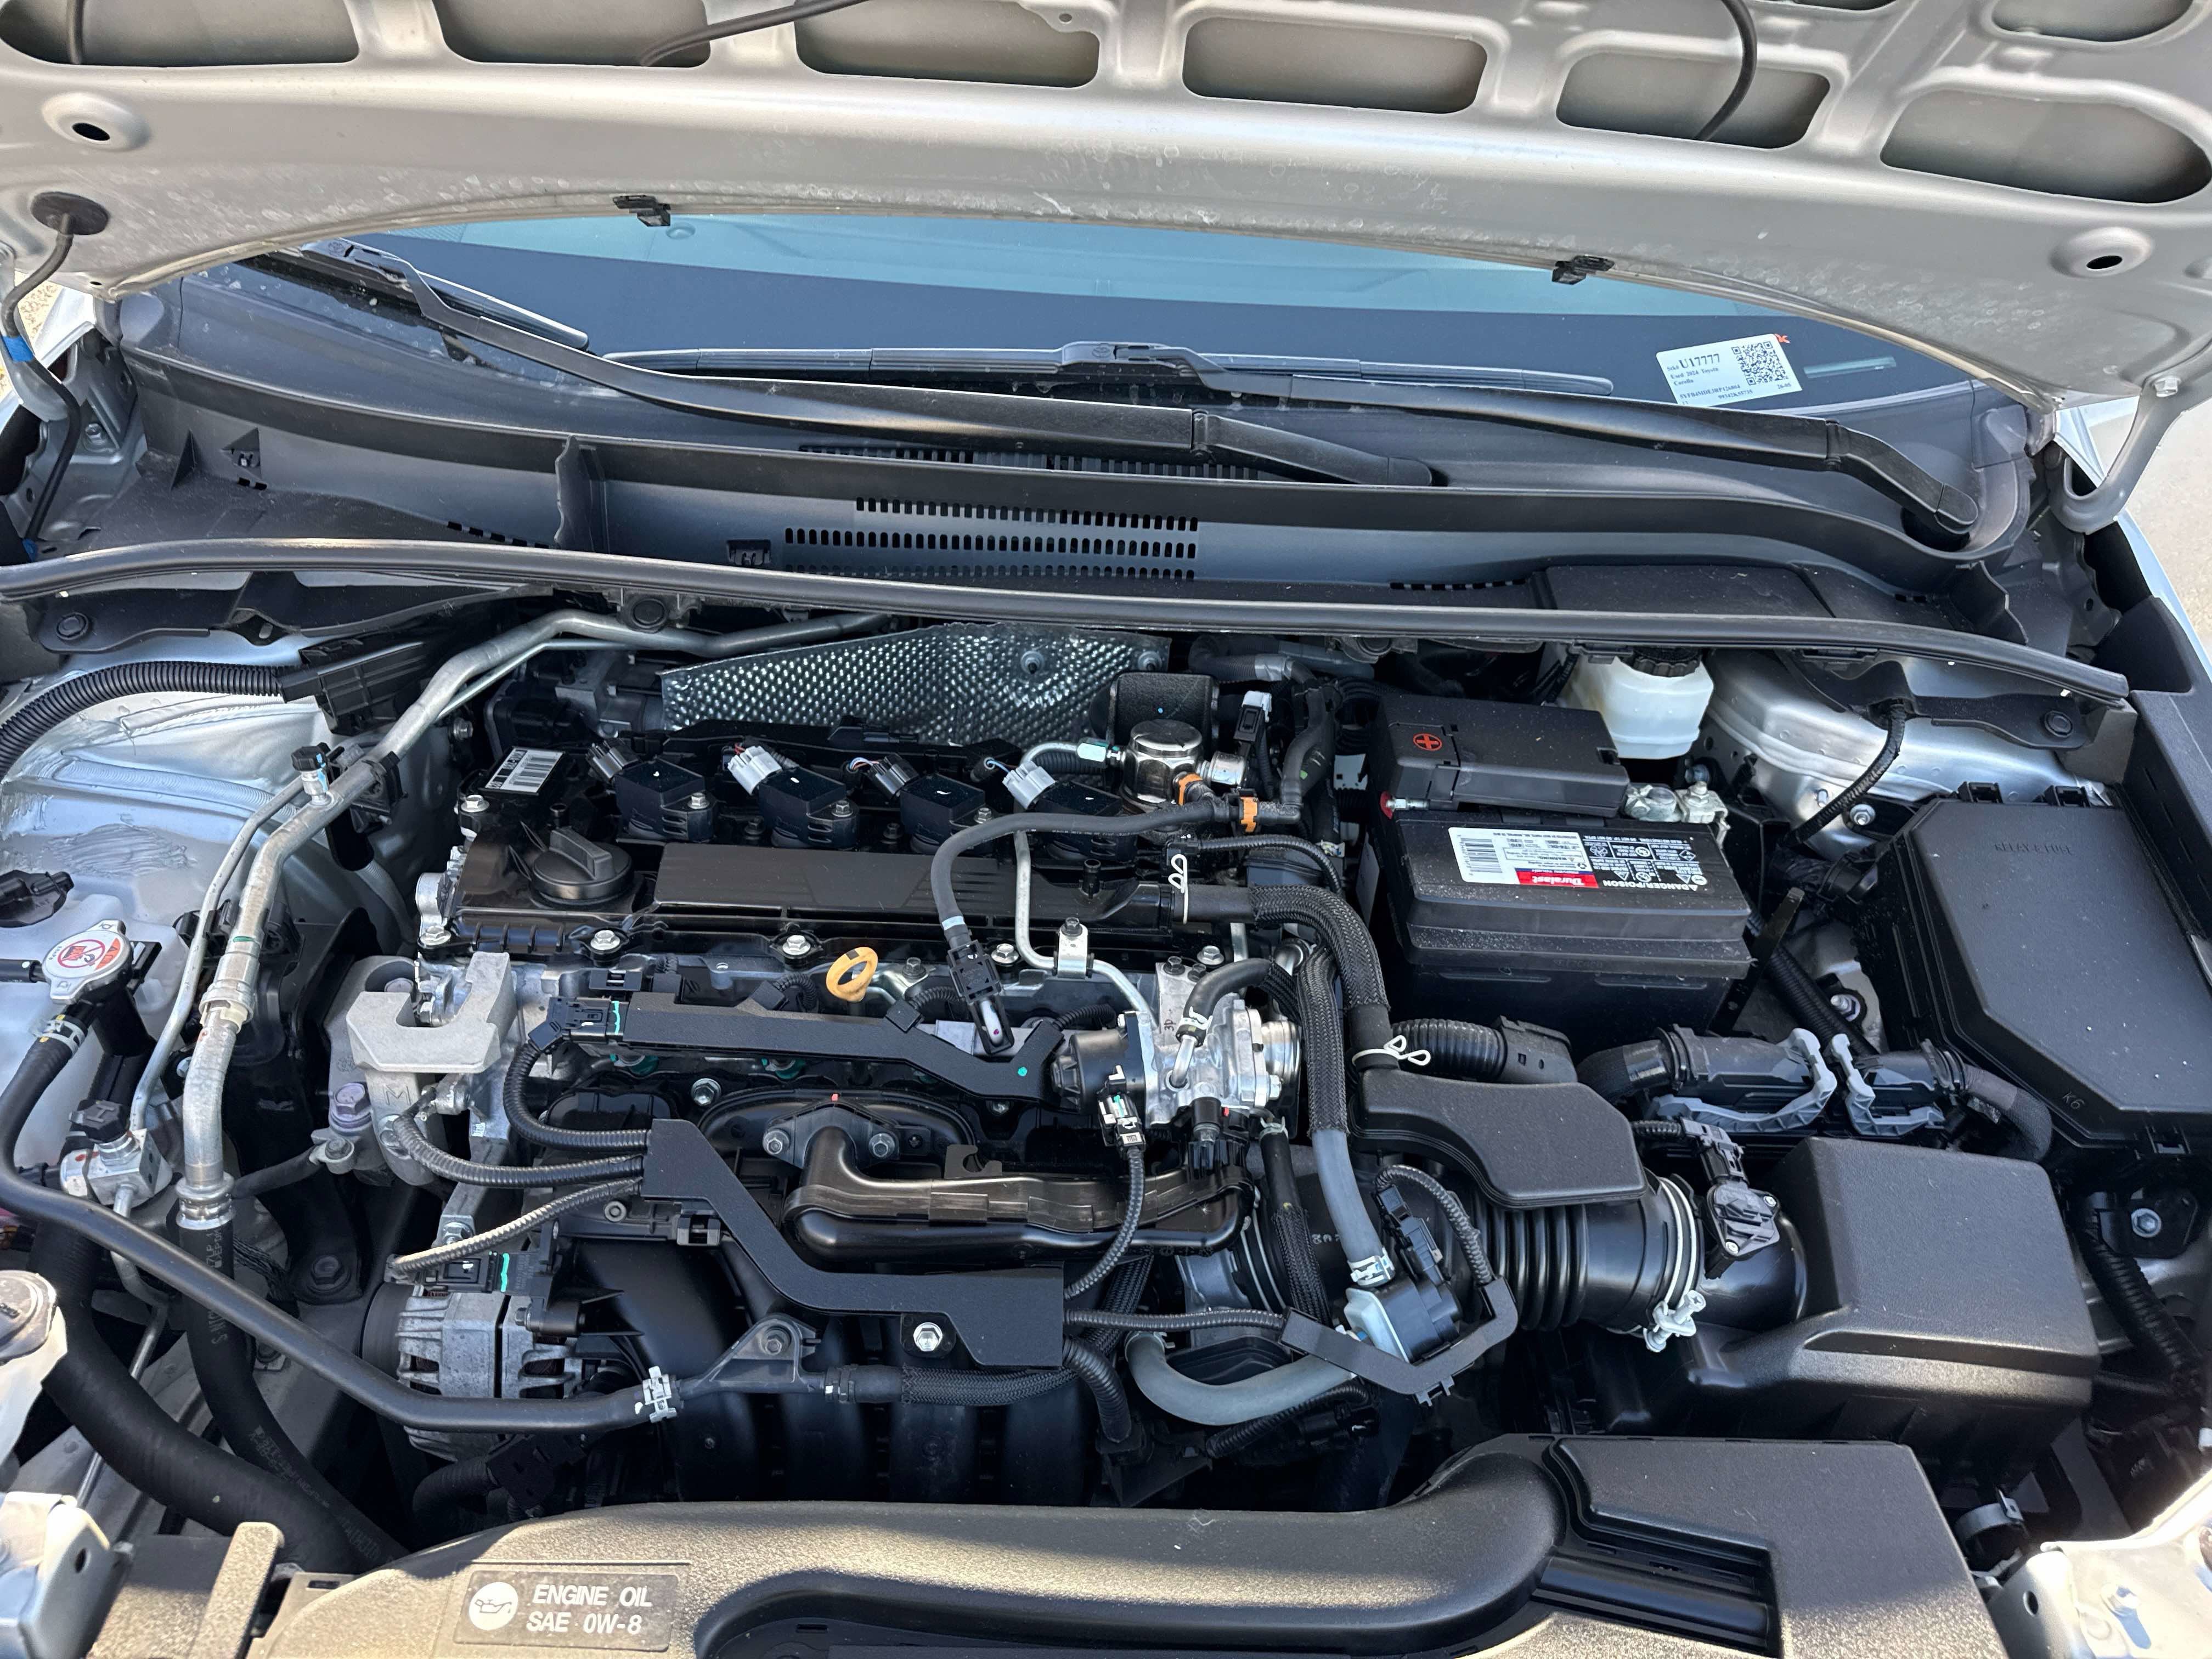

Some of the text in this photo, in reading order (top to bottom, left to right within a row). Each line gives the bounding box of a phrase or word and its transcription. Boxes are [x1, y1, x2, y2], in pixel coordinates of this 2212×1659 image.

[1679, 353, 1720, 369] U17777
[1531, 876, 1585, 886] Duralast
[1602, 880, 1690, 890] DANGER/POISON
[2062, 1091, 2085, 1110] K6
[86, 1103, 116, 1123] H
[532, 1583, 653, 1607] ENGINE OIL
[526, 1611, 642, 1635] SAE 0W-8
